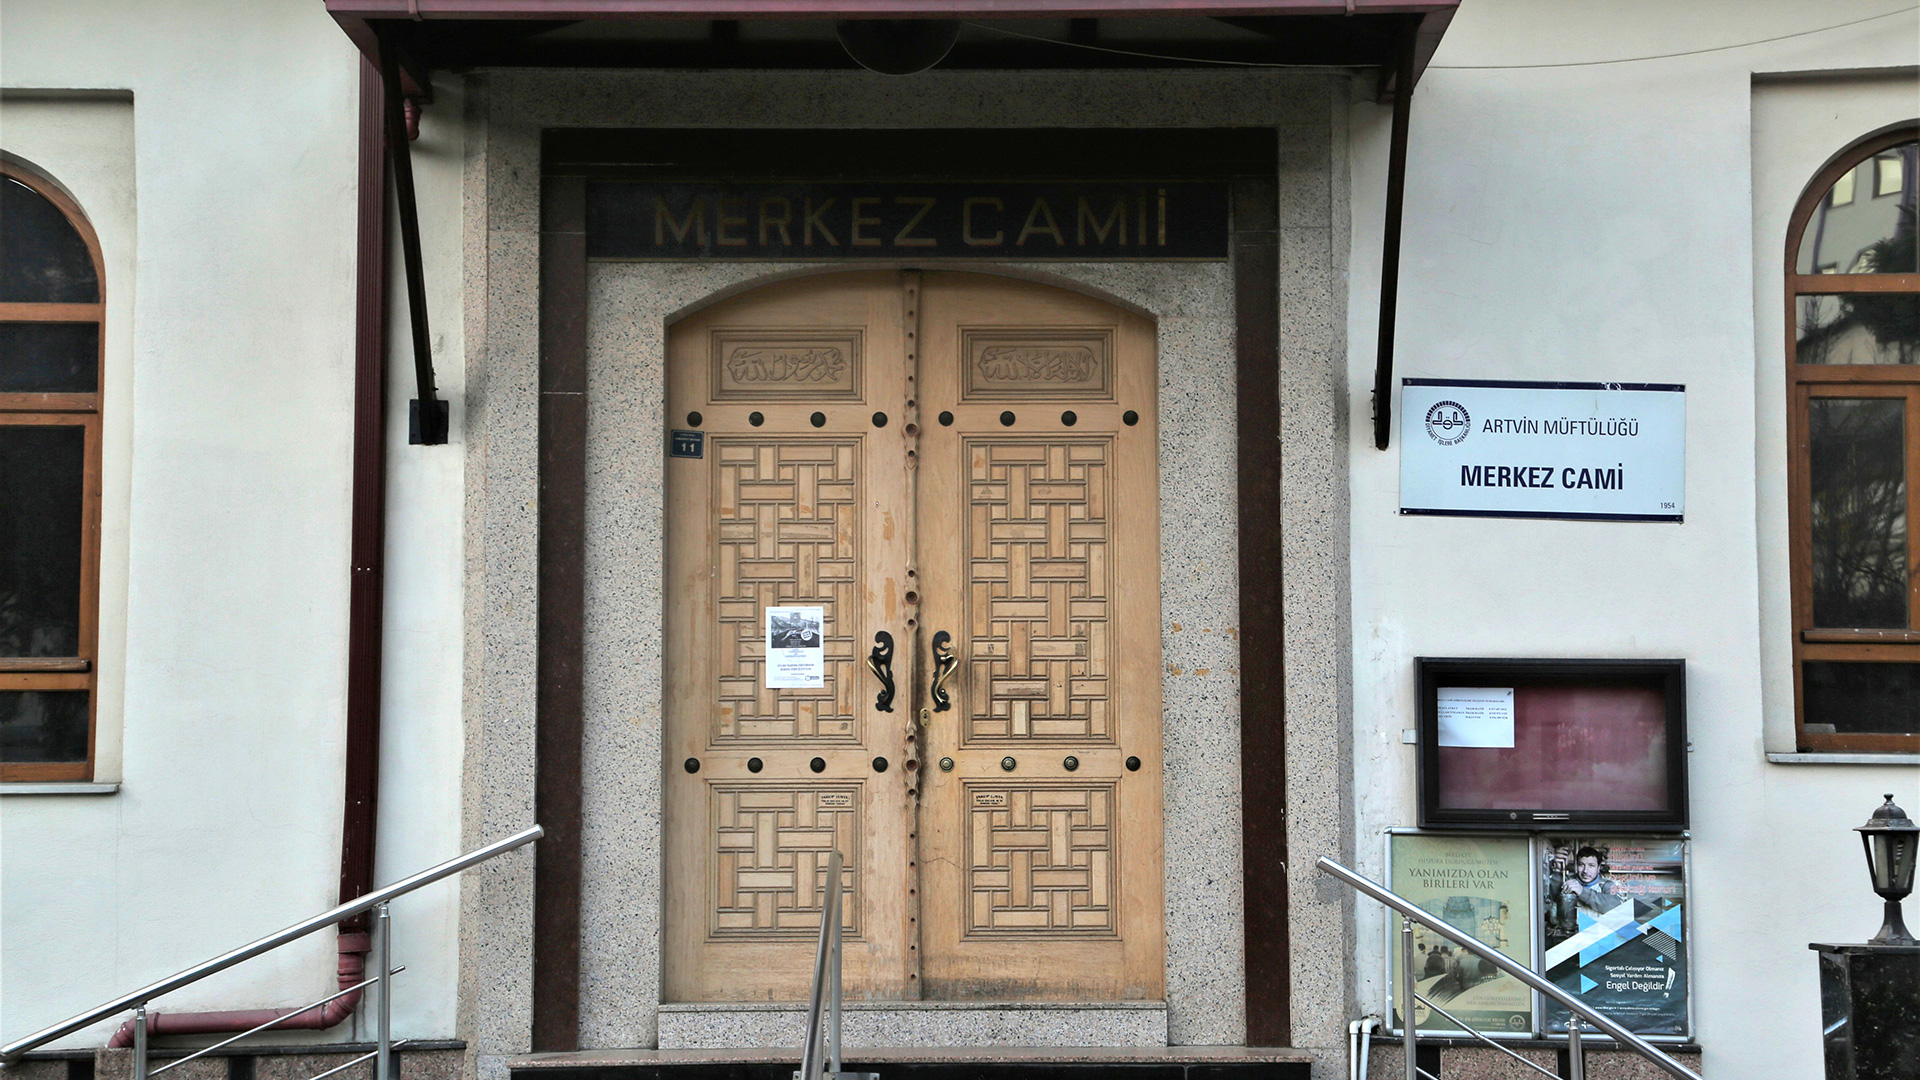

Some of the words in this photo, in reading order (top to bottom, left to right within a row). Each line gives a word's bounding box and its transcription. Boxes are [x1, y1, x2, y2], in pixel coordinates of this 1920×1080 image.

[654, 196, 938, 247] MERKEZ
[961, 187, 1167, 247] CAMİİ
[1482, 416, 1539, 434] ARTVİN
[1544, 416, 1639, 437] MÜFTÜLÜĞÜ
[681, 443, 695, 452] 11
[1461, 465, 1555, 489] MERKEZ
[1561, 463, 1623, 490] CAMİ
[1660, 502, 1675, 510] 1954
[1408, 868, 1474, 879] YANIMIZDA
[1477, 869, 1508, 879] OLAN
[1423, 878, 1469, 889] BİRİLERİ
[1473, 880, 1495, 889] VAR
[1606, 981, 1630, 992] Engel
